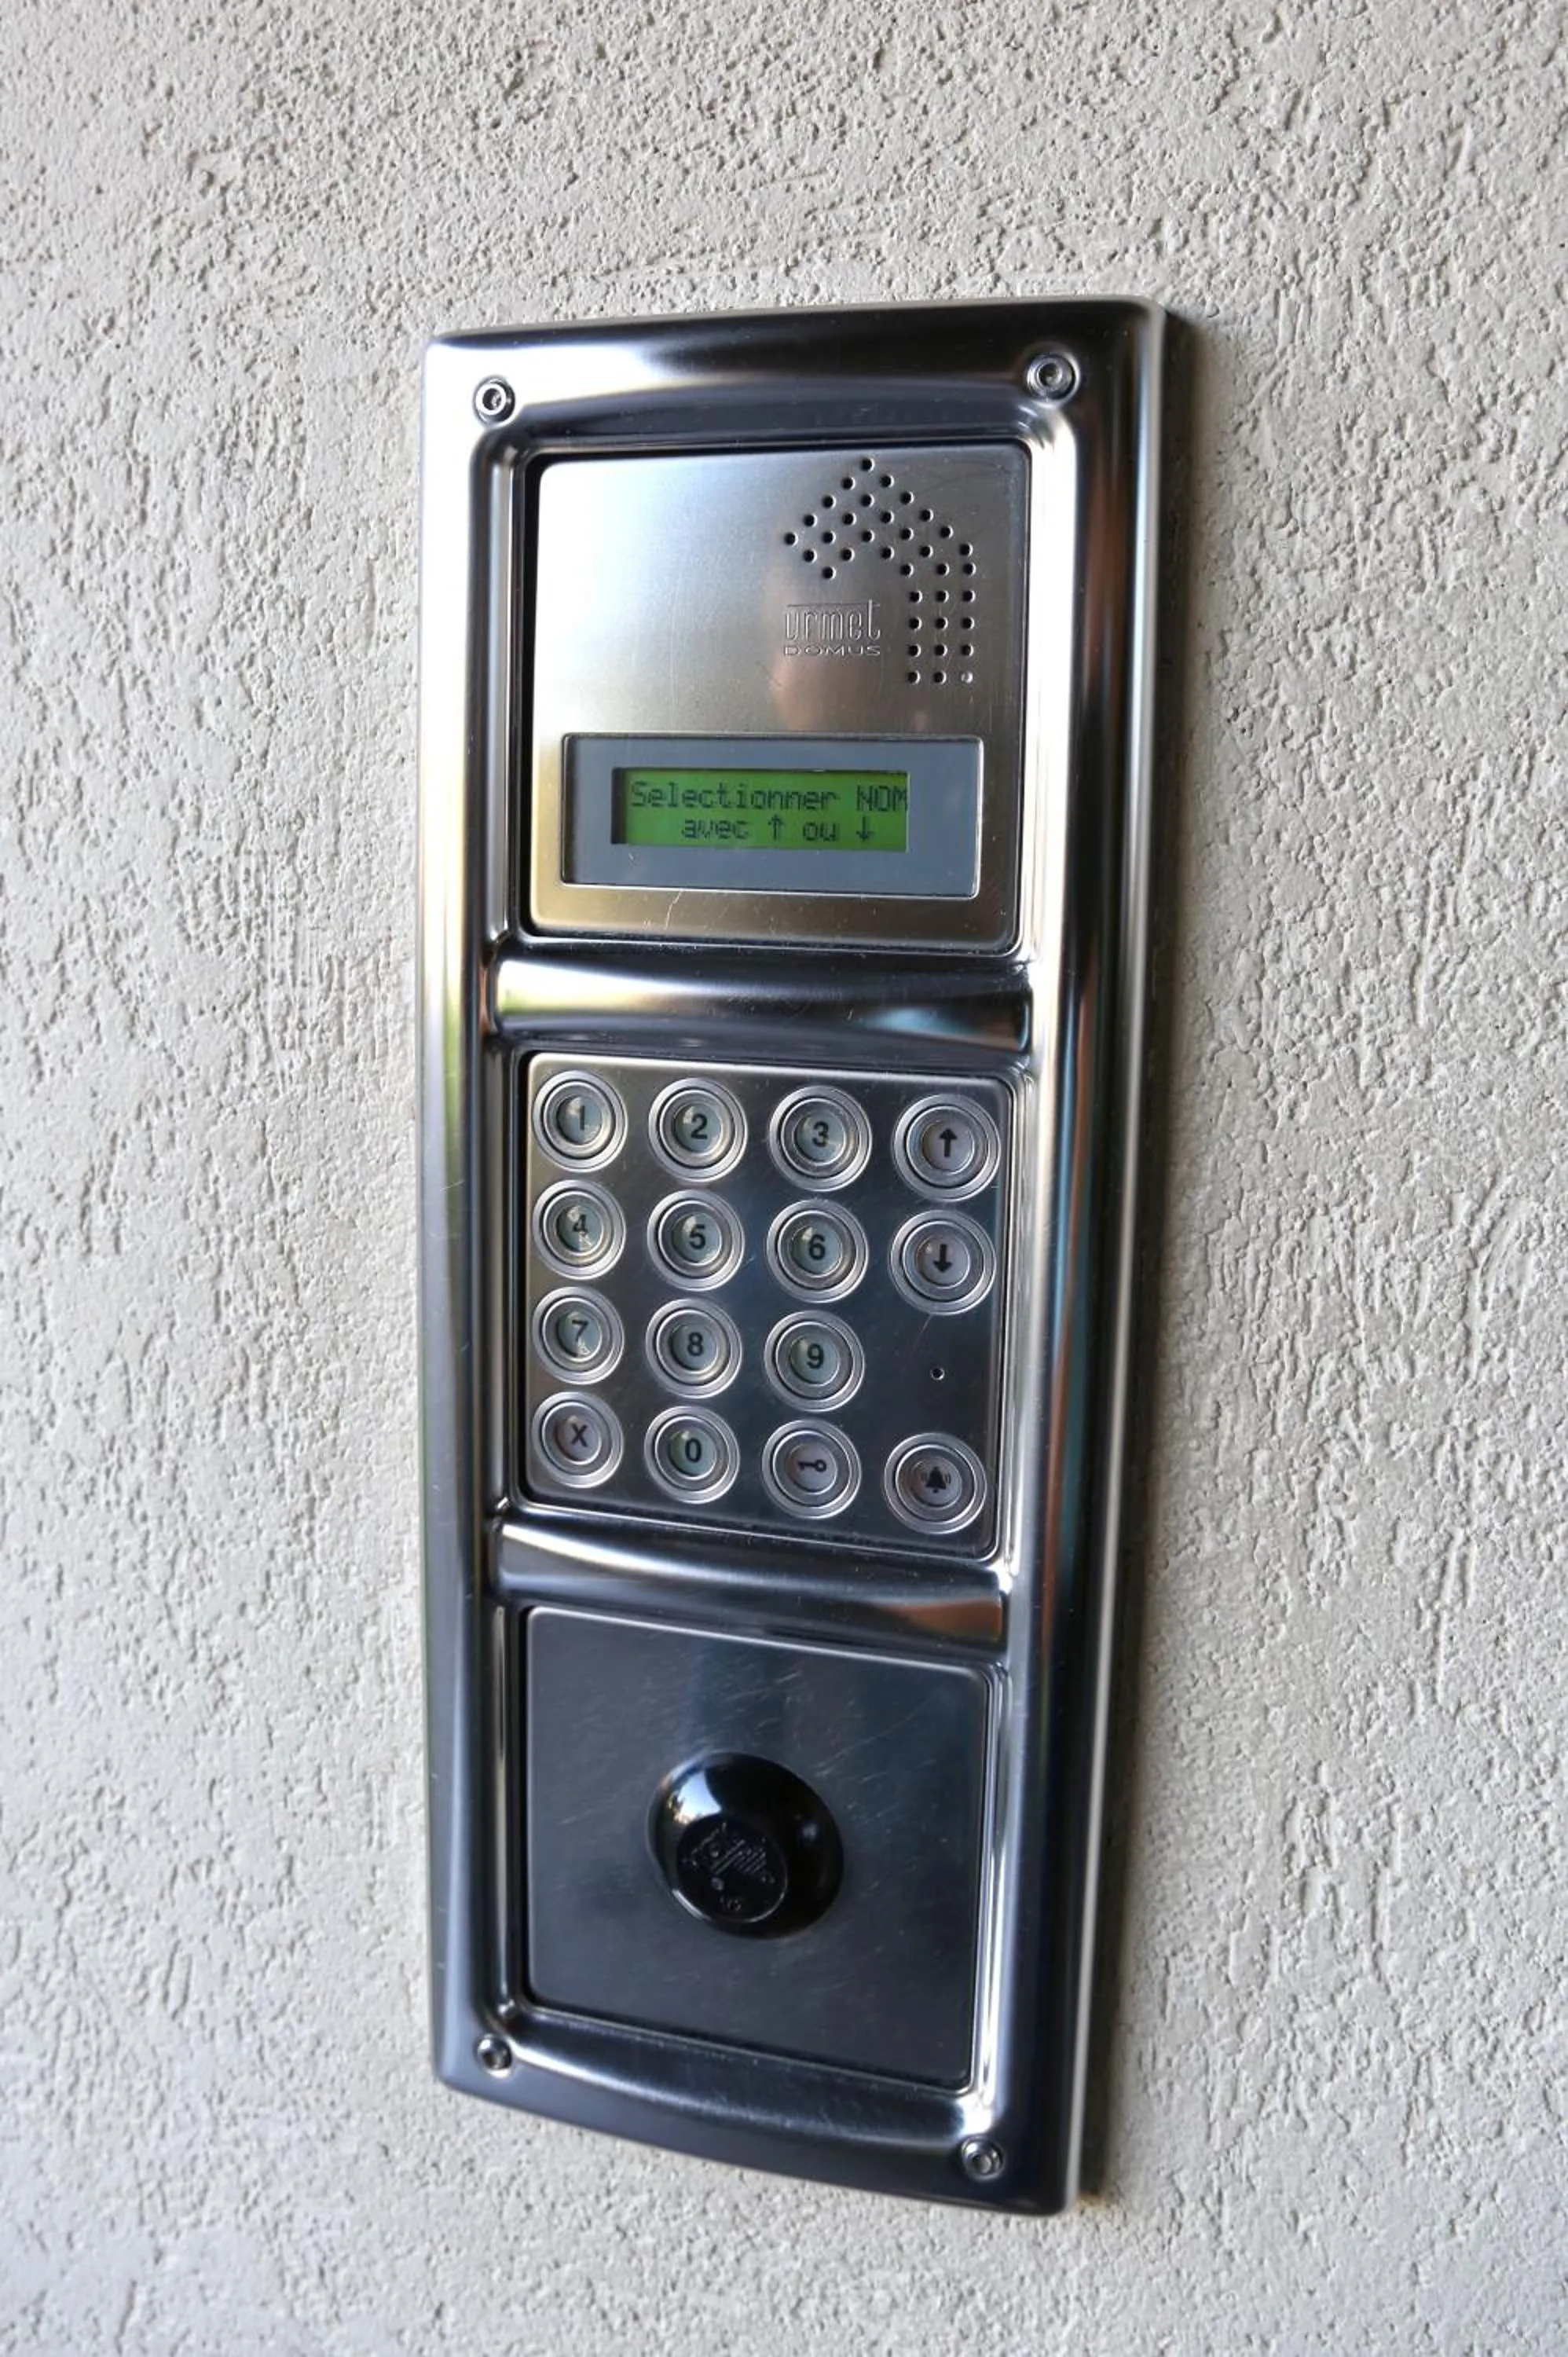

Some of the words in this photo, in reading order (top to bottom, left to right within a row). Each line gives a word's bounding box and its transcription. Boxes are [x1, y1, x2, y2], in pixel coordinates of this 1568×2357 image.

[785, 599, 881, 641] urmet
[783, 646, 881, 657] DOMUS
[630, 781, 839, 809] Selectionner
[856, 786, 908, 812] NOM
[680, 819, 749, 840] avec
[802, 821, 837, 841] ou
[577, 1105, 585, 1131] 1
[691, 1114, 707, 1139] 2
[813, 1121, 829, 1146] 3
[573, 1214, 587, 1237] 4
[690, 1225, 705, 1250] 5
[809, 1235, 825, 1260] 6
[572, 1320, 588, 1343] 7
[687, 1332, 703, 1357] 8
[807, 1344, 823, 1369] 9
[686, 1439, 702, 1462] 0
